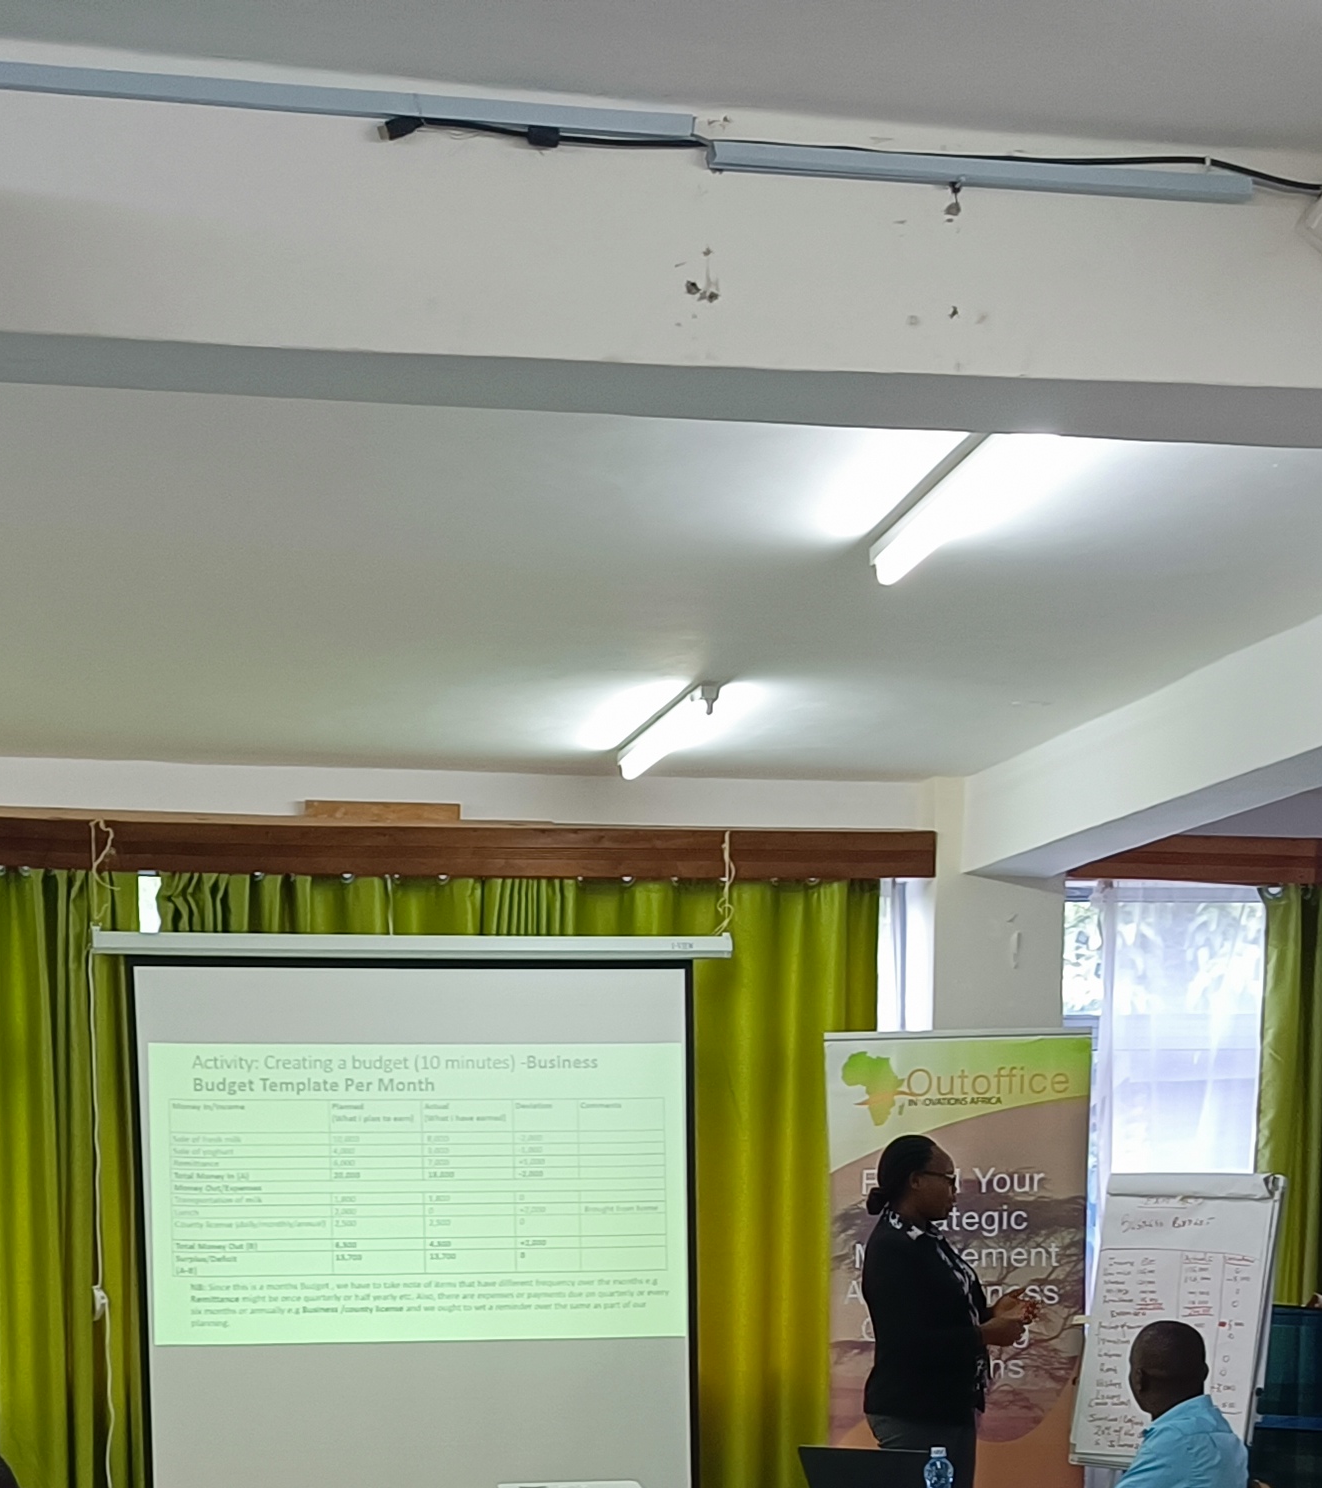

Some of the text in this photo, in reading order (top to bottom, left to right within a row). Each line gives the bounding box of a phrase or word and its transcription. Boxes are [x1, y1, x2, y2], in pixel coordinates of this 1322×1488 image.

[192, 1054, 598, 1073] Activity: Creating a budget (10 minutes) -Business
[192, 1077, 435, 1095] Budget Template Per Month
[906, 1065, 1070, 1097] Outoffice
[908, 1096, 1002, 1107] INOVATIONS AFRICA
[973, 1167, 1045, 1194] Your
[938, 1205, 1028, 1236] ategic
